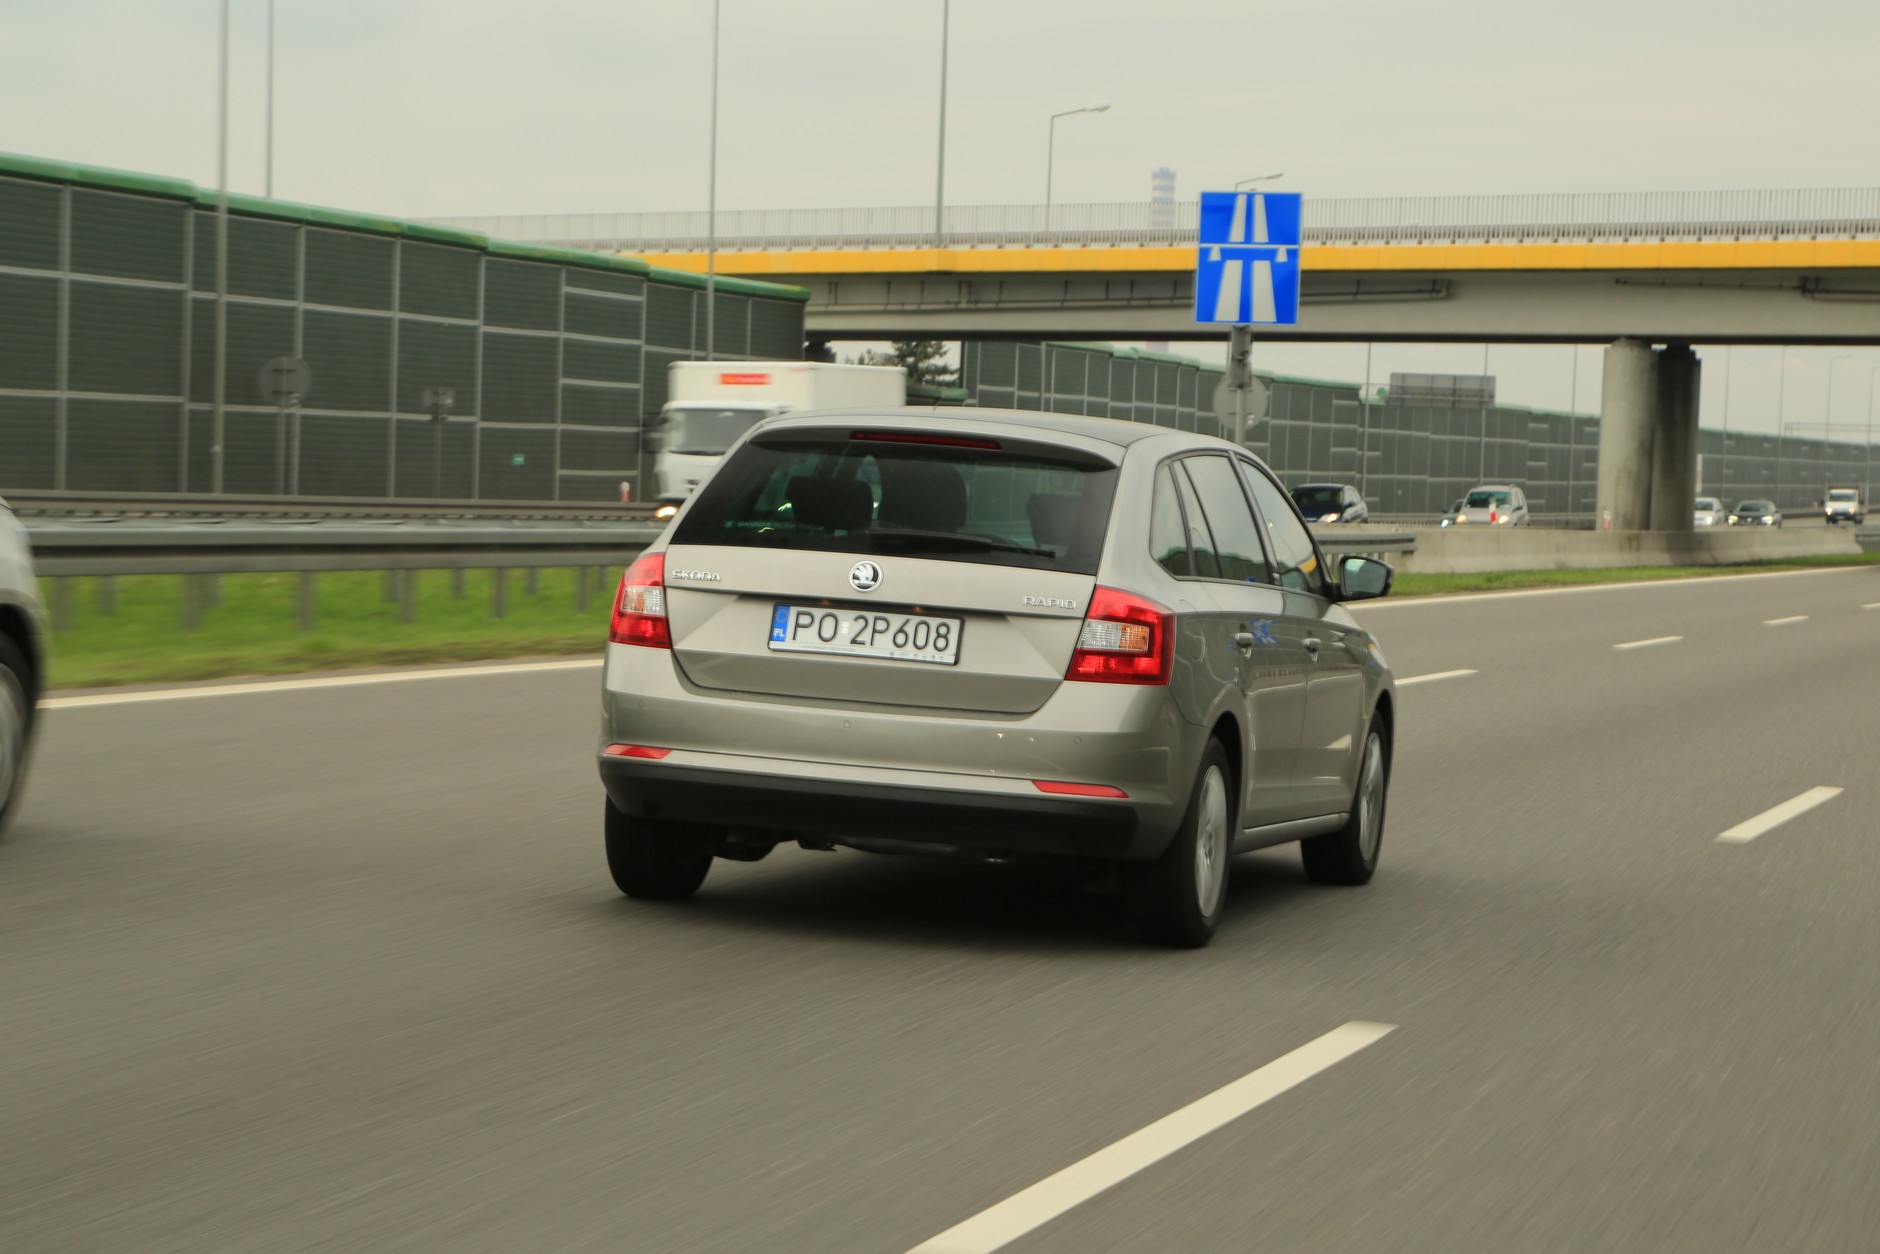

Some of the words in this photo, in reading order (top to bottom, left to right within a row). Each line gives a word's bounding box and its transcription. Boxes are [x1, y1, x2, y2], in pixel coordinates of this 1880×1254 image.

[1022, 595, 1078, 609] RAPID
[792, 610, 839, 643] PO
[850, 614, 951, 652] 2P608
